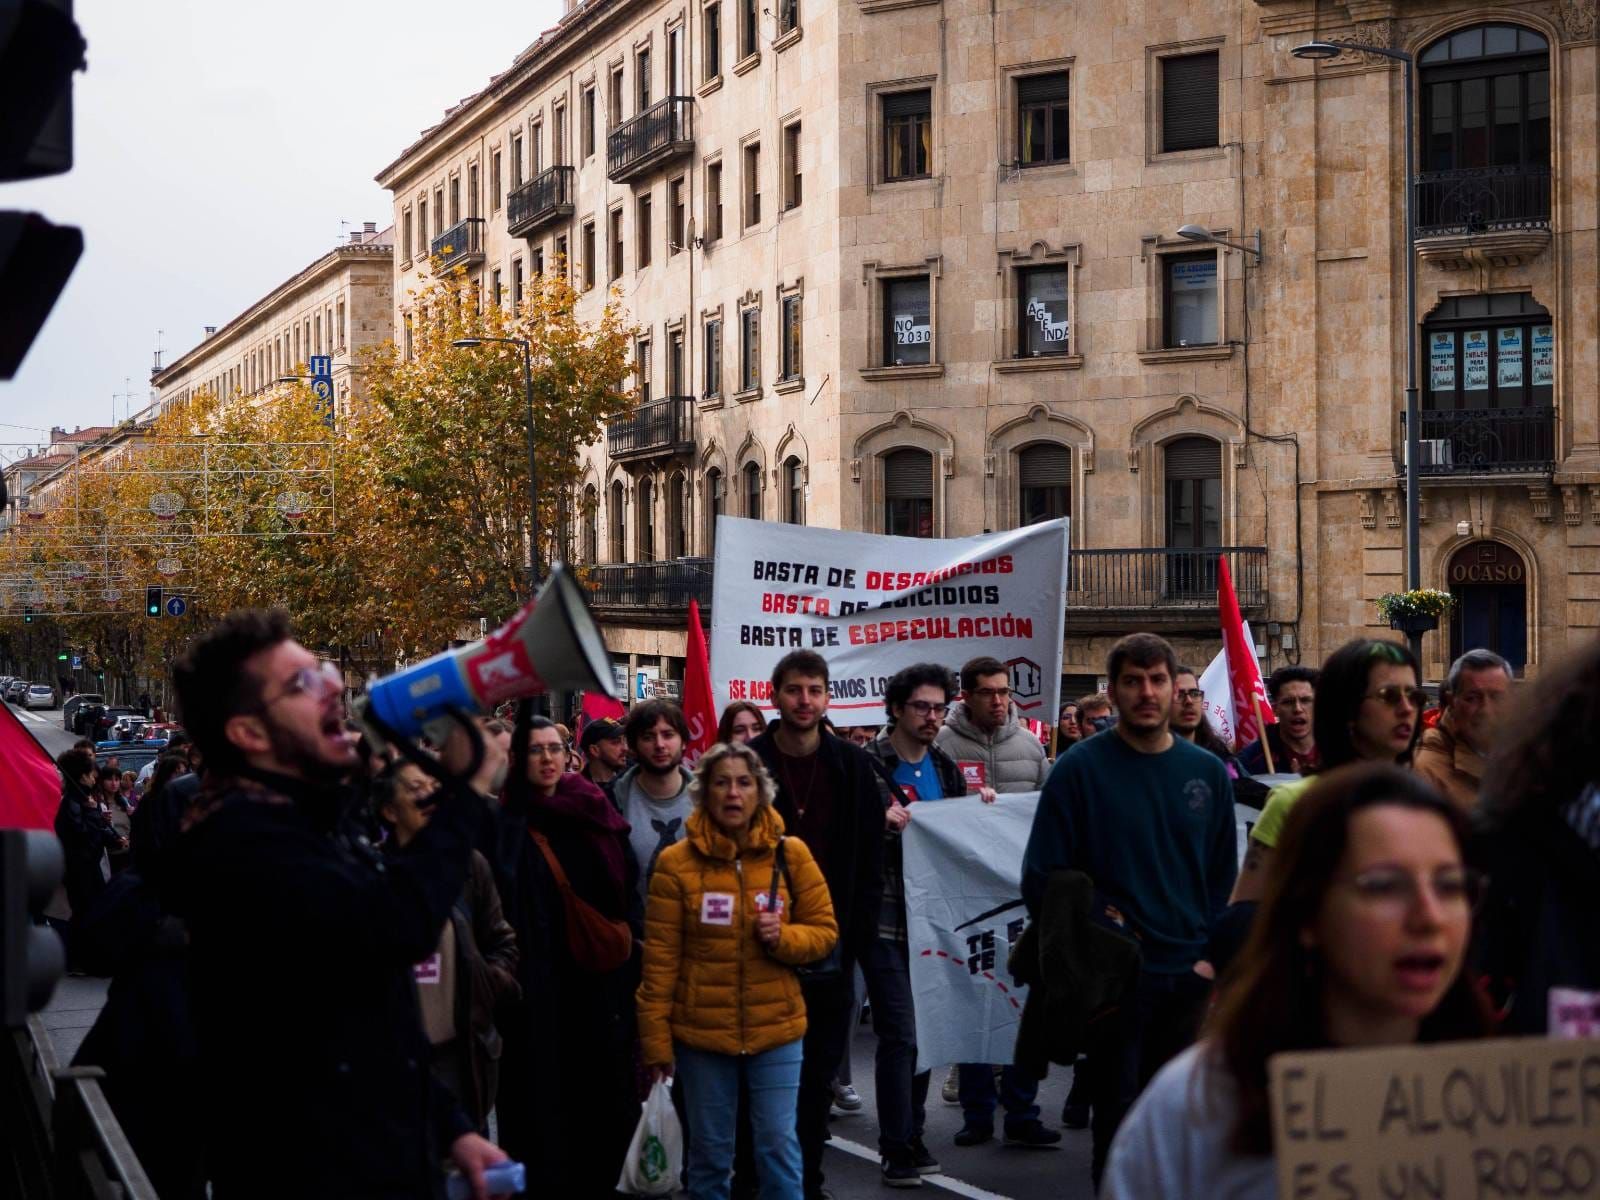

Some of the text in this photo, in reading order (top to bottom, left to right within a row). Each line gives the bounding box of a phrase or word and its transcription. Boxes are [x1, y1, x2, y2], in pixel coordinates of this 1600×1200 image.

[895, 319, 913, 332] NO
[898, 330, 931, 344] 2030
[314, 359, 329, 376] H
[1534, 358, 1553, 366] INGLÉ
[753, 555, 1013, 591] BASTA DE DESAHUCIOS
[1453, 564, 1522, 581] OCASO
[762, 593, 830, 617] BASTA
[840, 600, 869, 617] DE
[740, 612, 1033, 648] BASTA DE ESPECULACIÓN
[729, 680, 747, 700] ¡SE
[750, 680, 774, 700] ACA
[828, 677, 867, 699] EMOS
[966, 929, 995, 955] TE
[1282, 1055, 1600, 1141] EL ALQUILER
[1378, 1156, 1446, 1200] UN
[1474, 1145, 1596, 1198] ROBO
